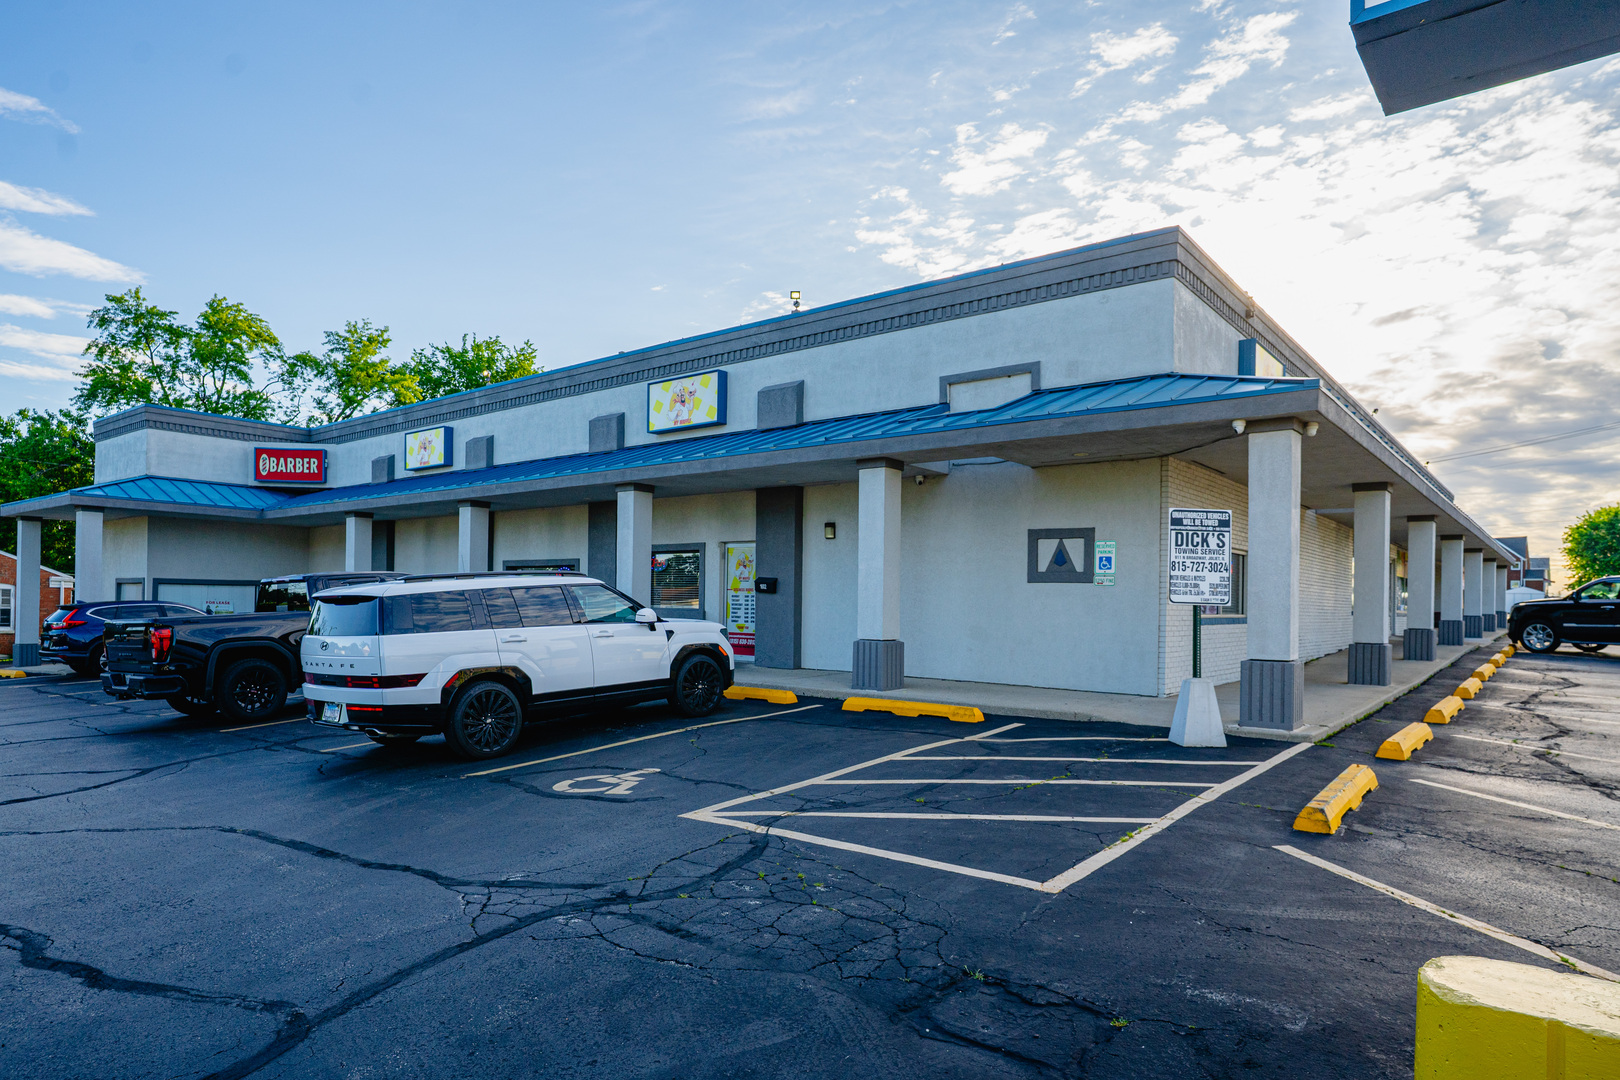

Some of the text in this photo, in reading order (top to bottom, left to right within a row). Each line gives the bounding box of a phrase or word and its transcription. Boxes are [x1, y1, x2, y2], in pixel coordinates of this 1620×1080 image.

[270, 457, 318, 473] BARBER
[1183, 518, 1195, 526] WILL
[1202, 519, 1219, 527] TOWED
[1175, 531, 1226, 549] DICK'S
[1200, 548, 1226, 556] SERVICE
[1171, 560, 1229, 573] 815-727-3024
